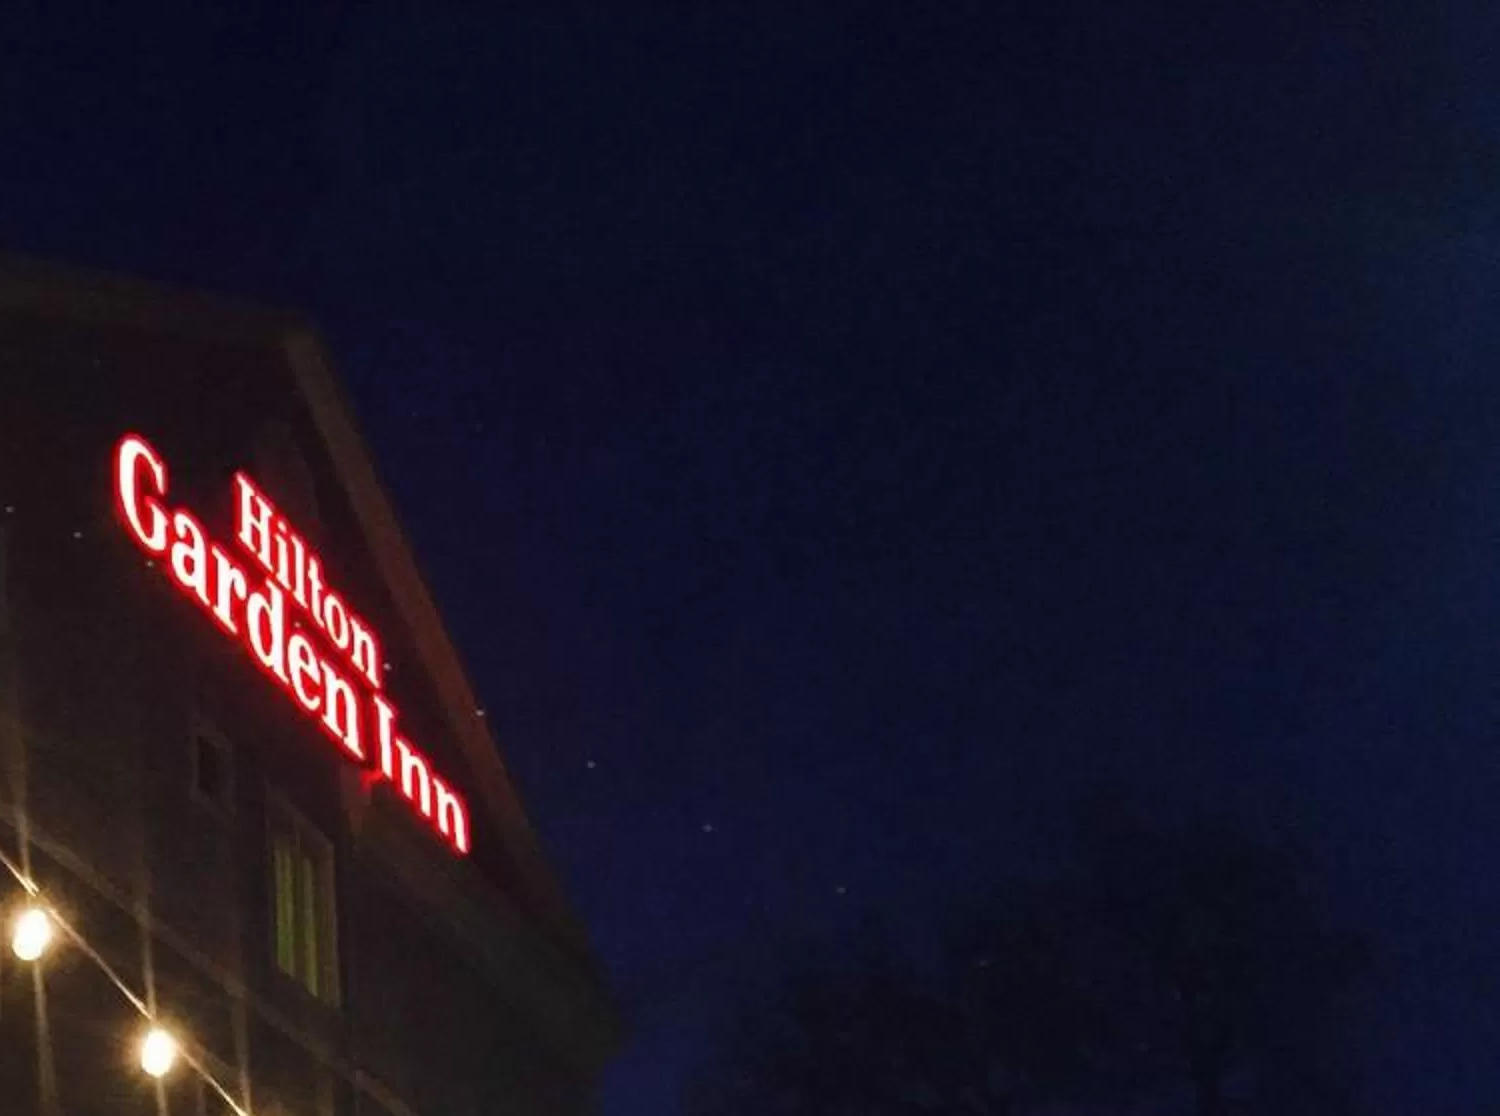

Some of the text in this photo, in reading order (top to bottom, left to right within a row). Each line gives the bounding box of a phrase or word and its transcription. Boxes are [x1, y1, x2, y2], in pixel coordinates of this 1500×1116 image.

[116, 436, 470, 855] Garden Inn
[234, 470, 382, 689] Hilton
